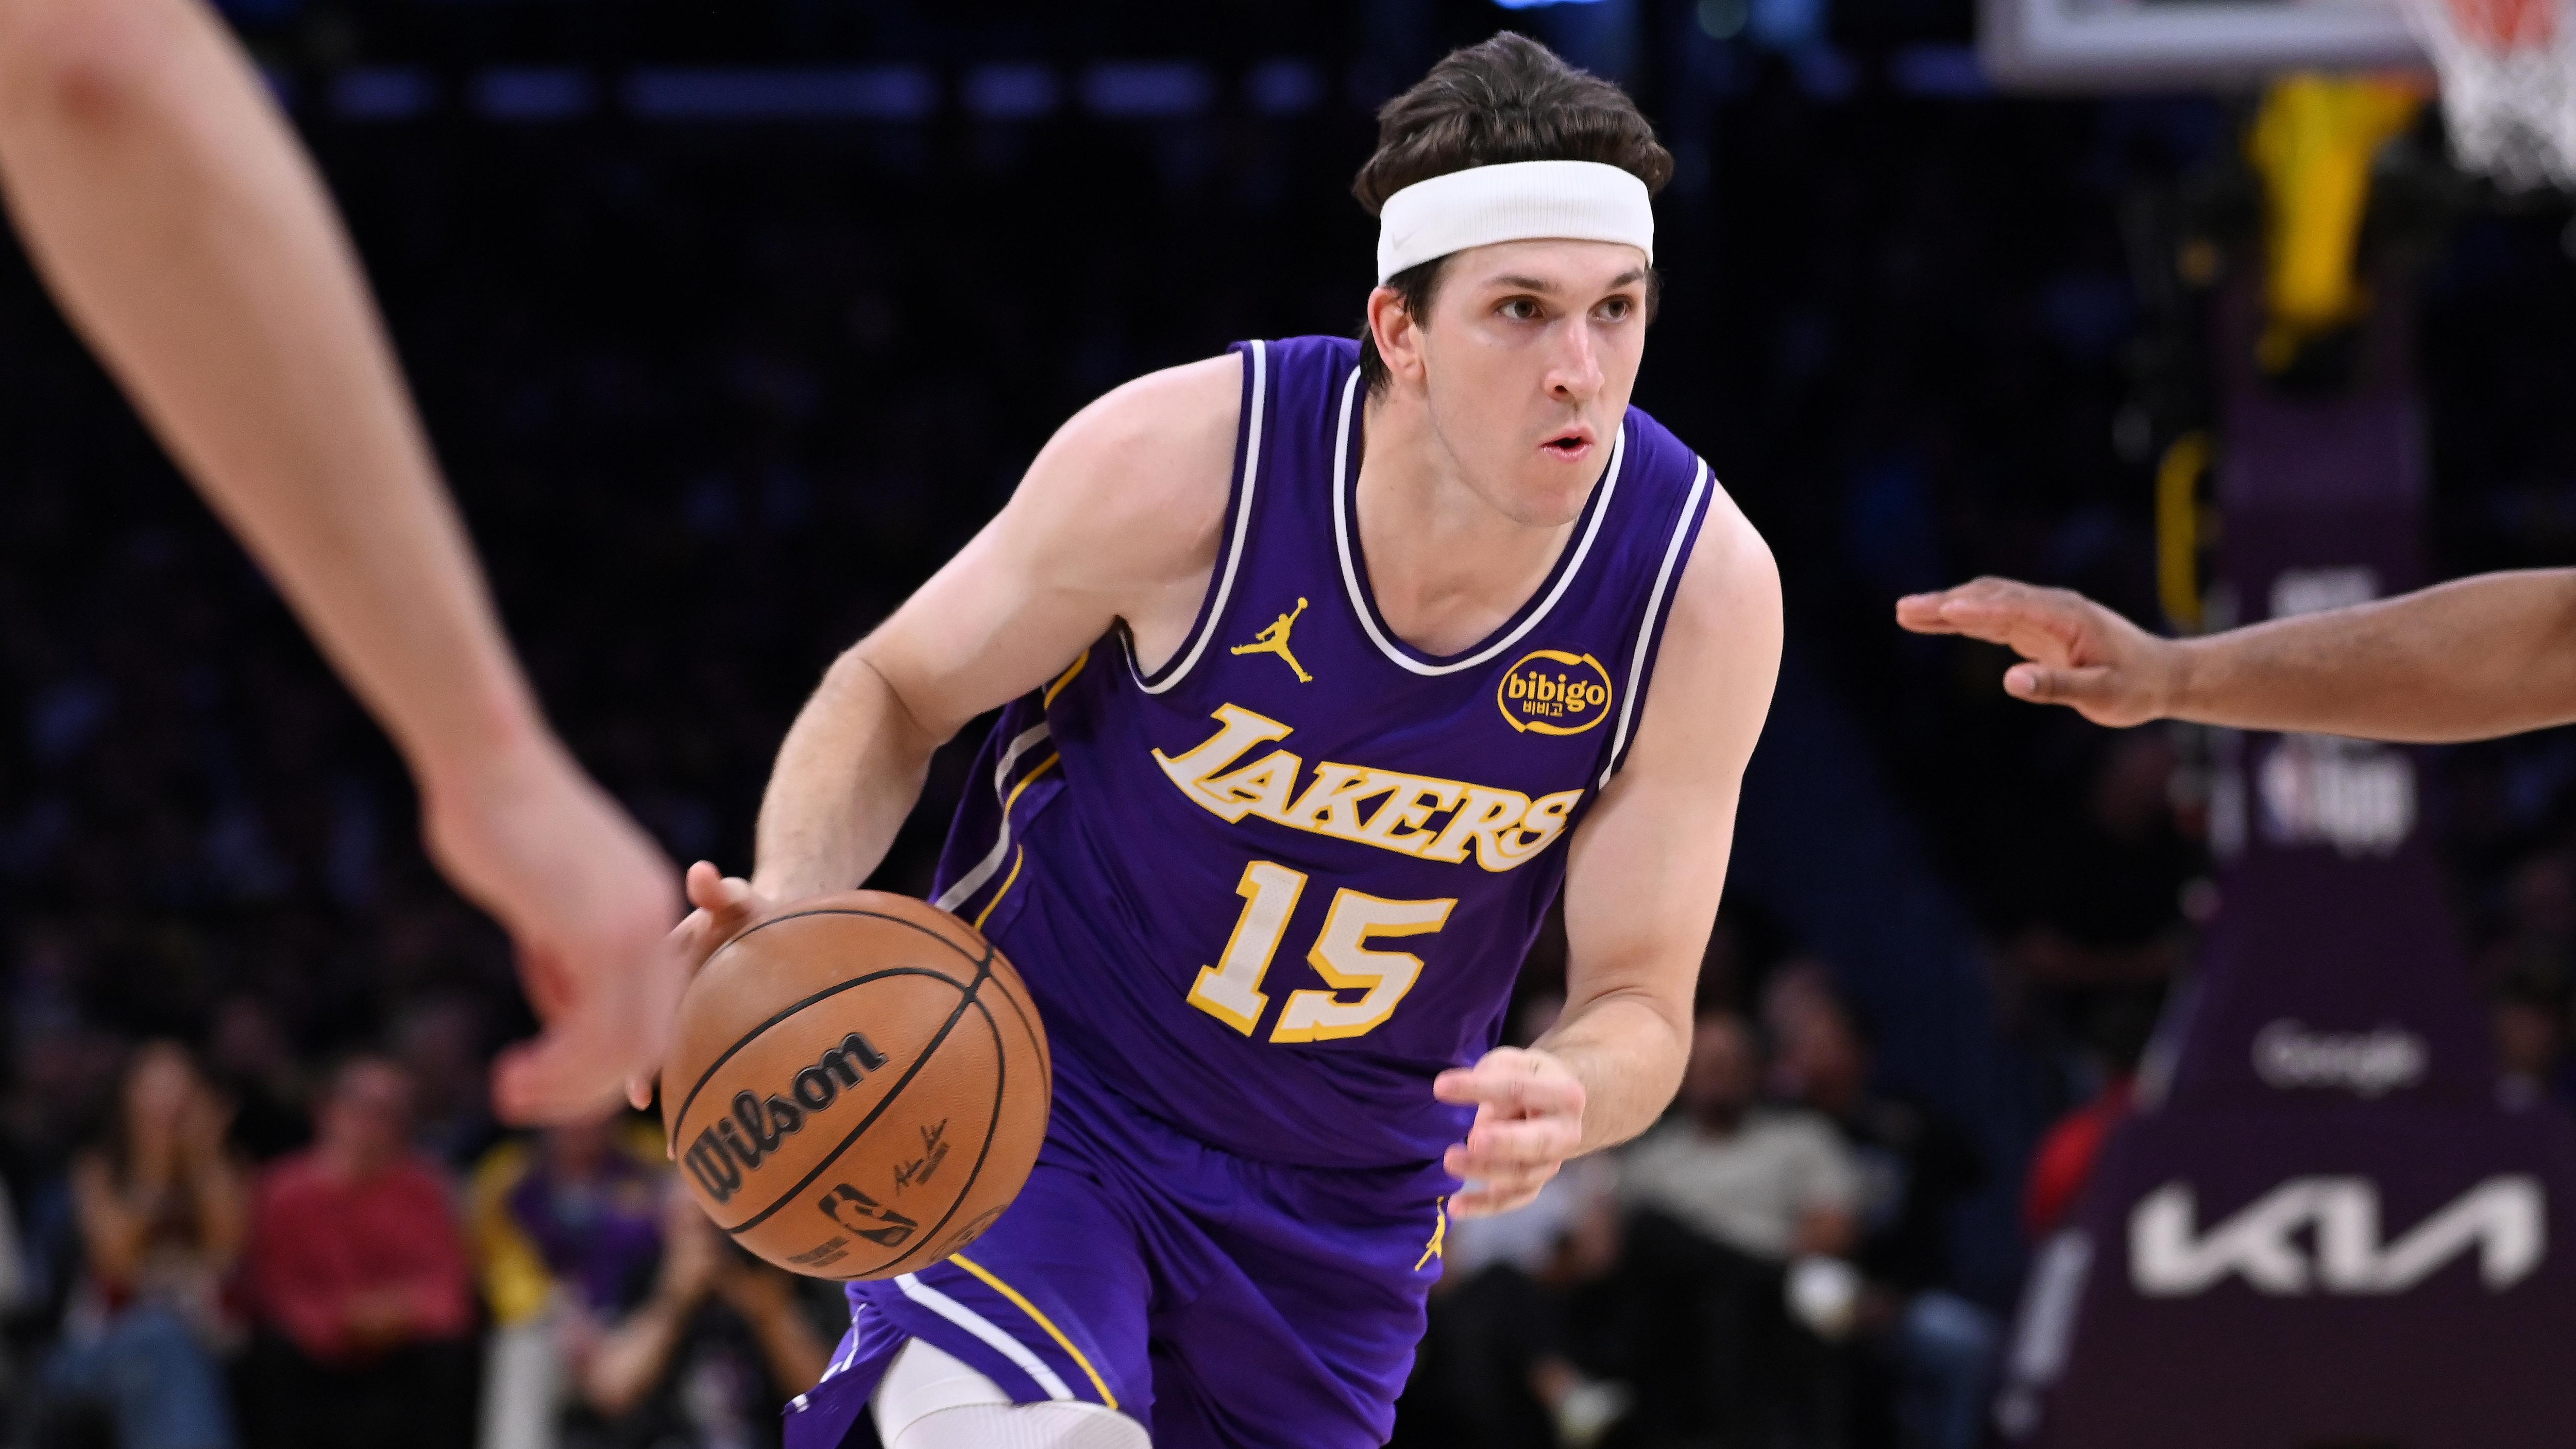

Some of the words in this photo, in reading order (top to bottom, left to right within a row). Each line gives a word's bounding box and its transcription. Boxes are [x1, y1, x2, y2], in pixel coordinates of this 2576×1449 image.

[1509, 671, 1605, 712] bibigo
[1523, 700, 1563, 717] 비비고
[1153, 702, 1584, 872] LAKERS
[1187, 861, 1458, 1043] 15
[685, 1032, 889, 1204] Wilson
